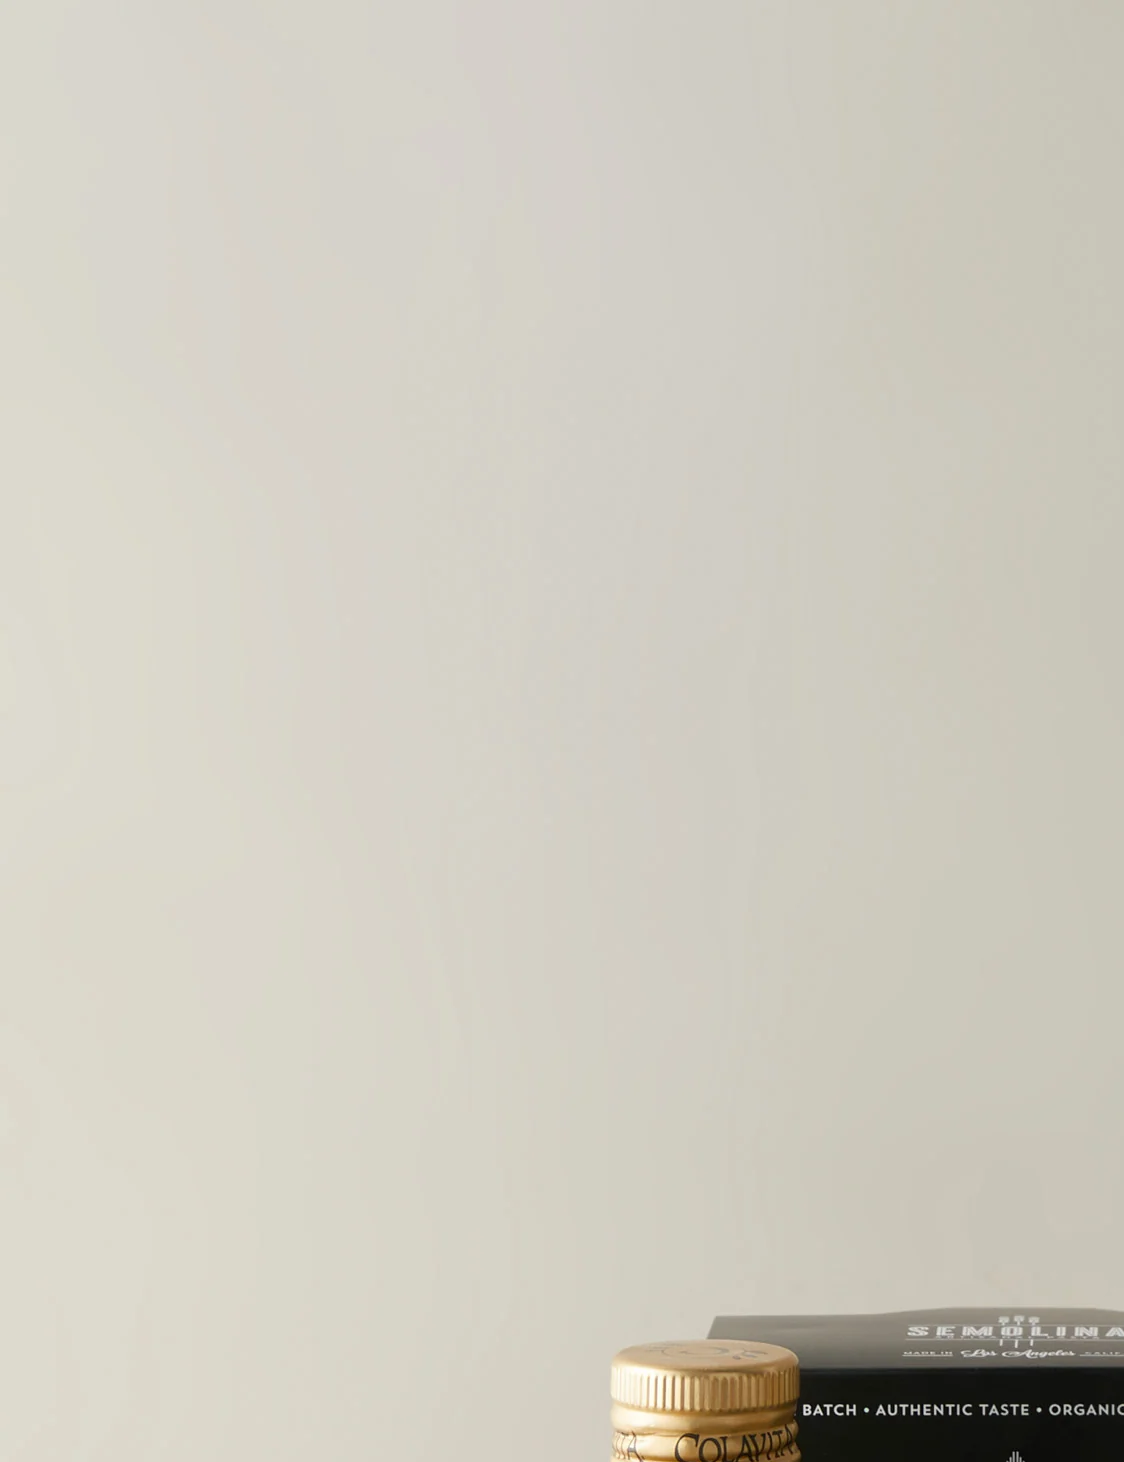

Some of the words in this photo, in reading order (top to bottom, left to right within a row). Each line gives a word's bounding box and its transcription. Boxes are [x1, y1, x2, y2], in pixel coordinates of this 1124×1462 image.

[961, 1349, 997, 1358] Los
[1002, 1349, 1076, 1359] Angeles
[802, 1403, 857, 1417] BATCH
[875, 1403, 973, 1417] AUTHENTIC
[979, 1403, 1030, 1417] TASTE
